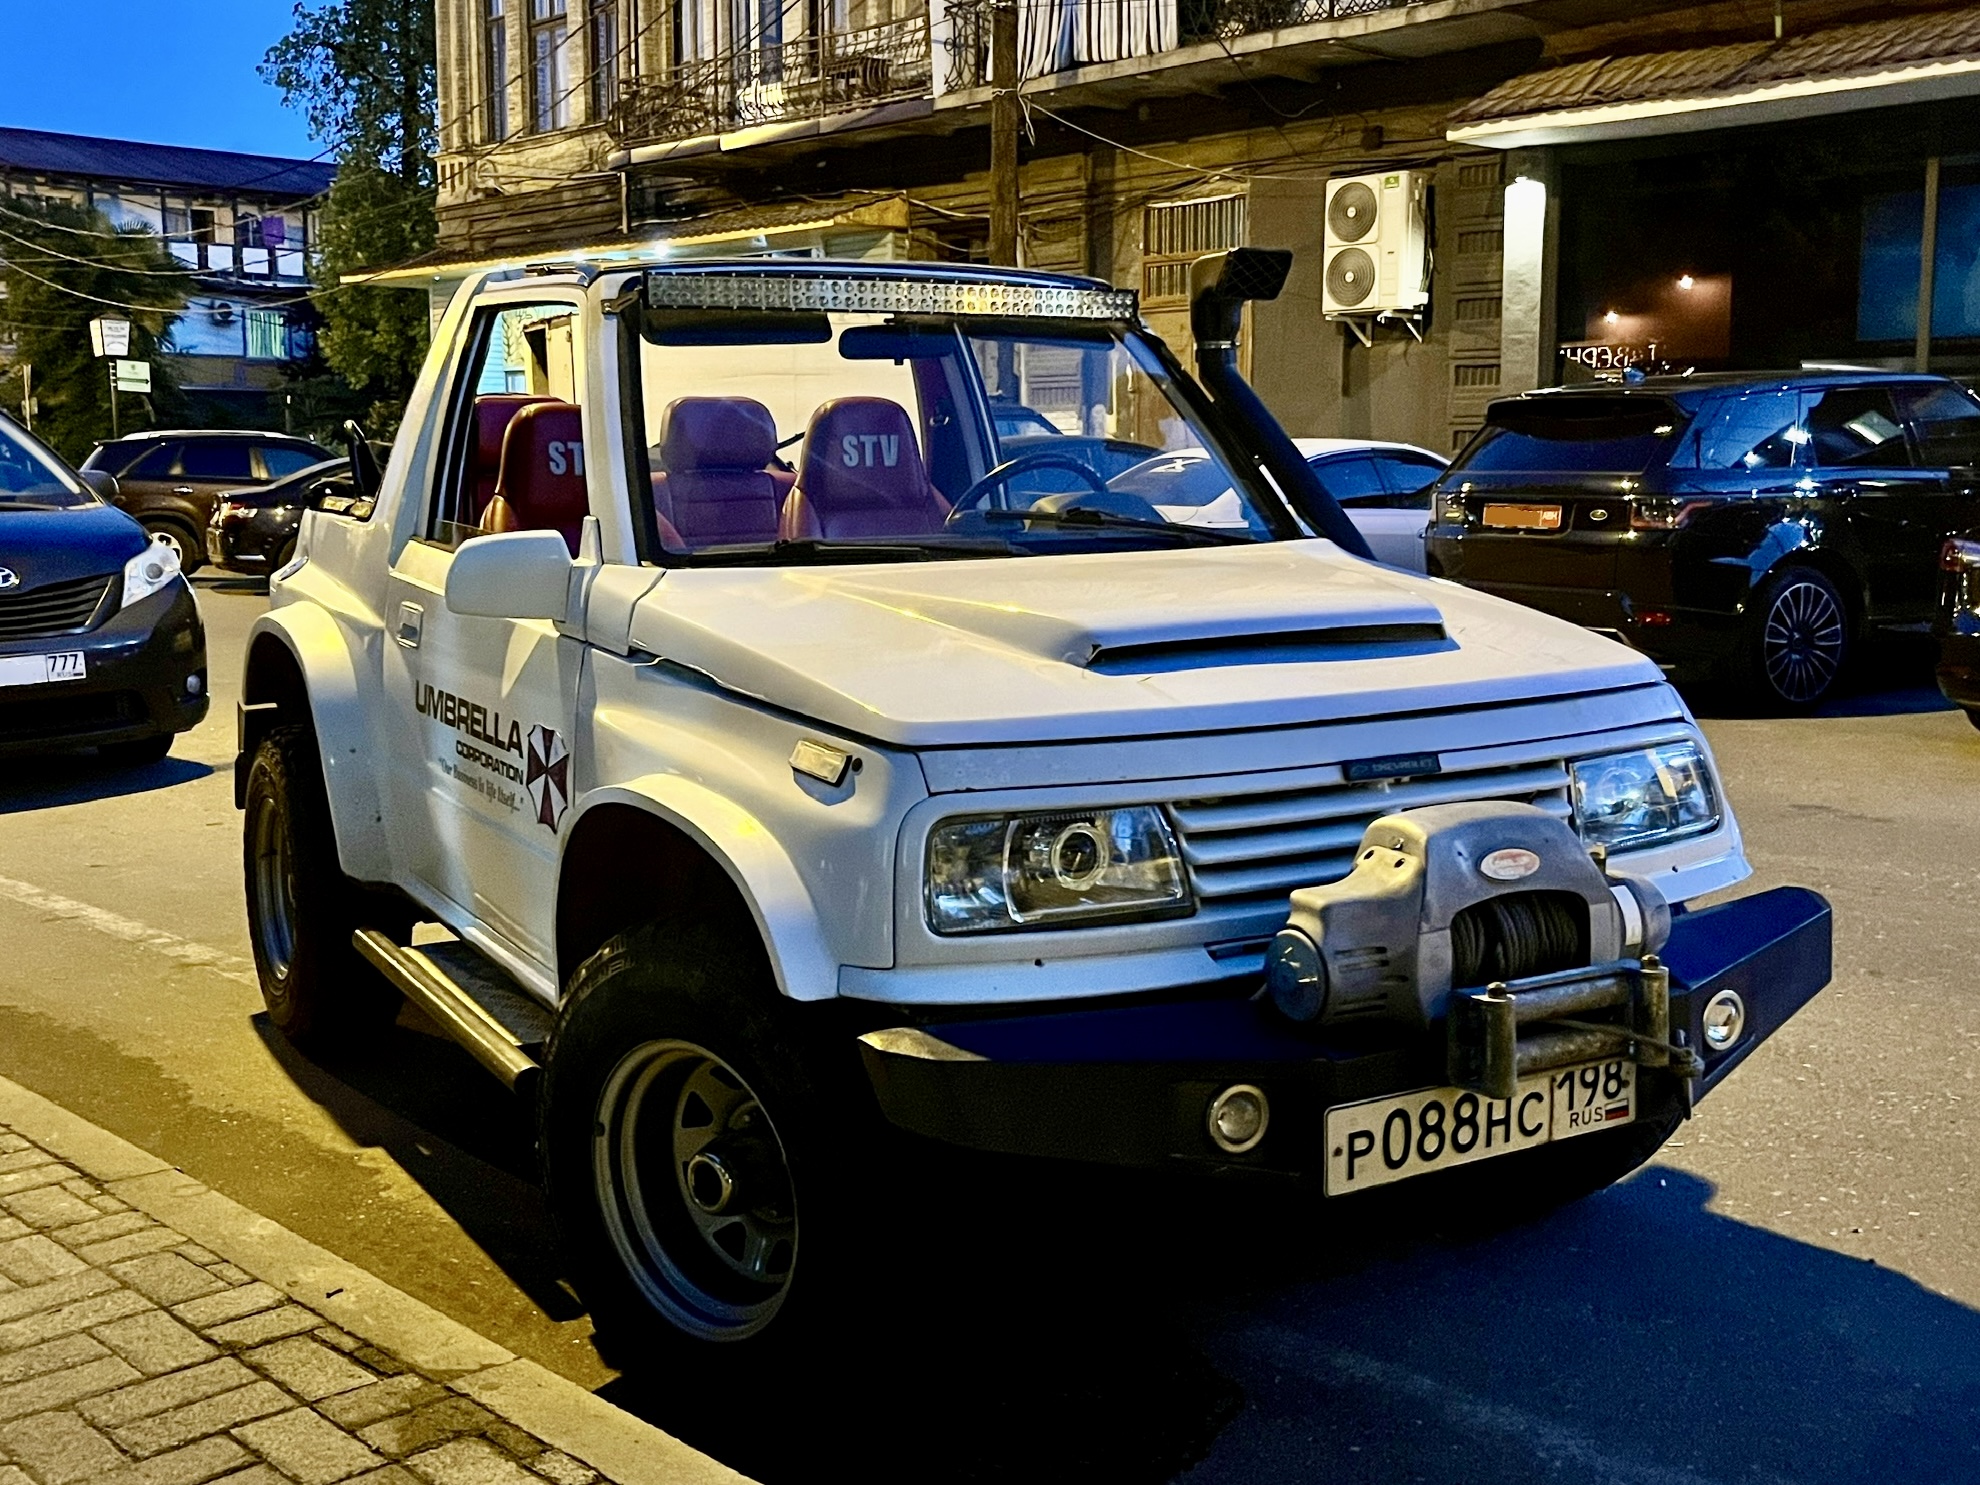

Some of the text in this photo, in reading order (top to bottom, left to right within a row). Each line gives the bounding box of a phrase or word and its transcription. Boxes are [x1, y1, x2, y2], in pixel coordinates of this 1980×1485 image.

[548, 441, 583, 476] ST
[842, 434, 899, 468] STV
[48, 654, 78, 672] 777
[415, 680, 523, 759] UMBRELLA
[456, 740, 523, 785] CORPORATION
[1556, 1060, 1623, 1111] 198
[1568, 1106, 1604, 1129] RUS
